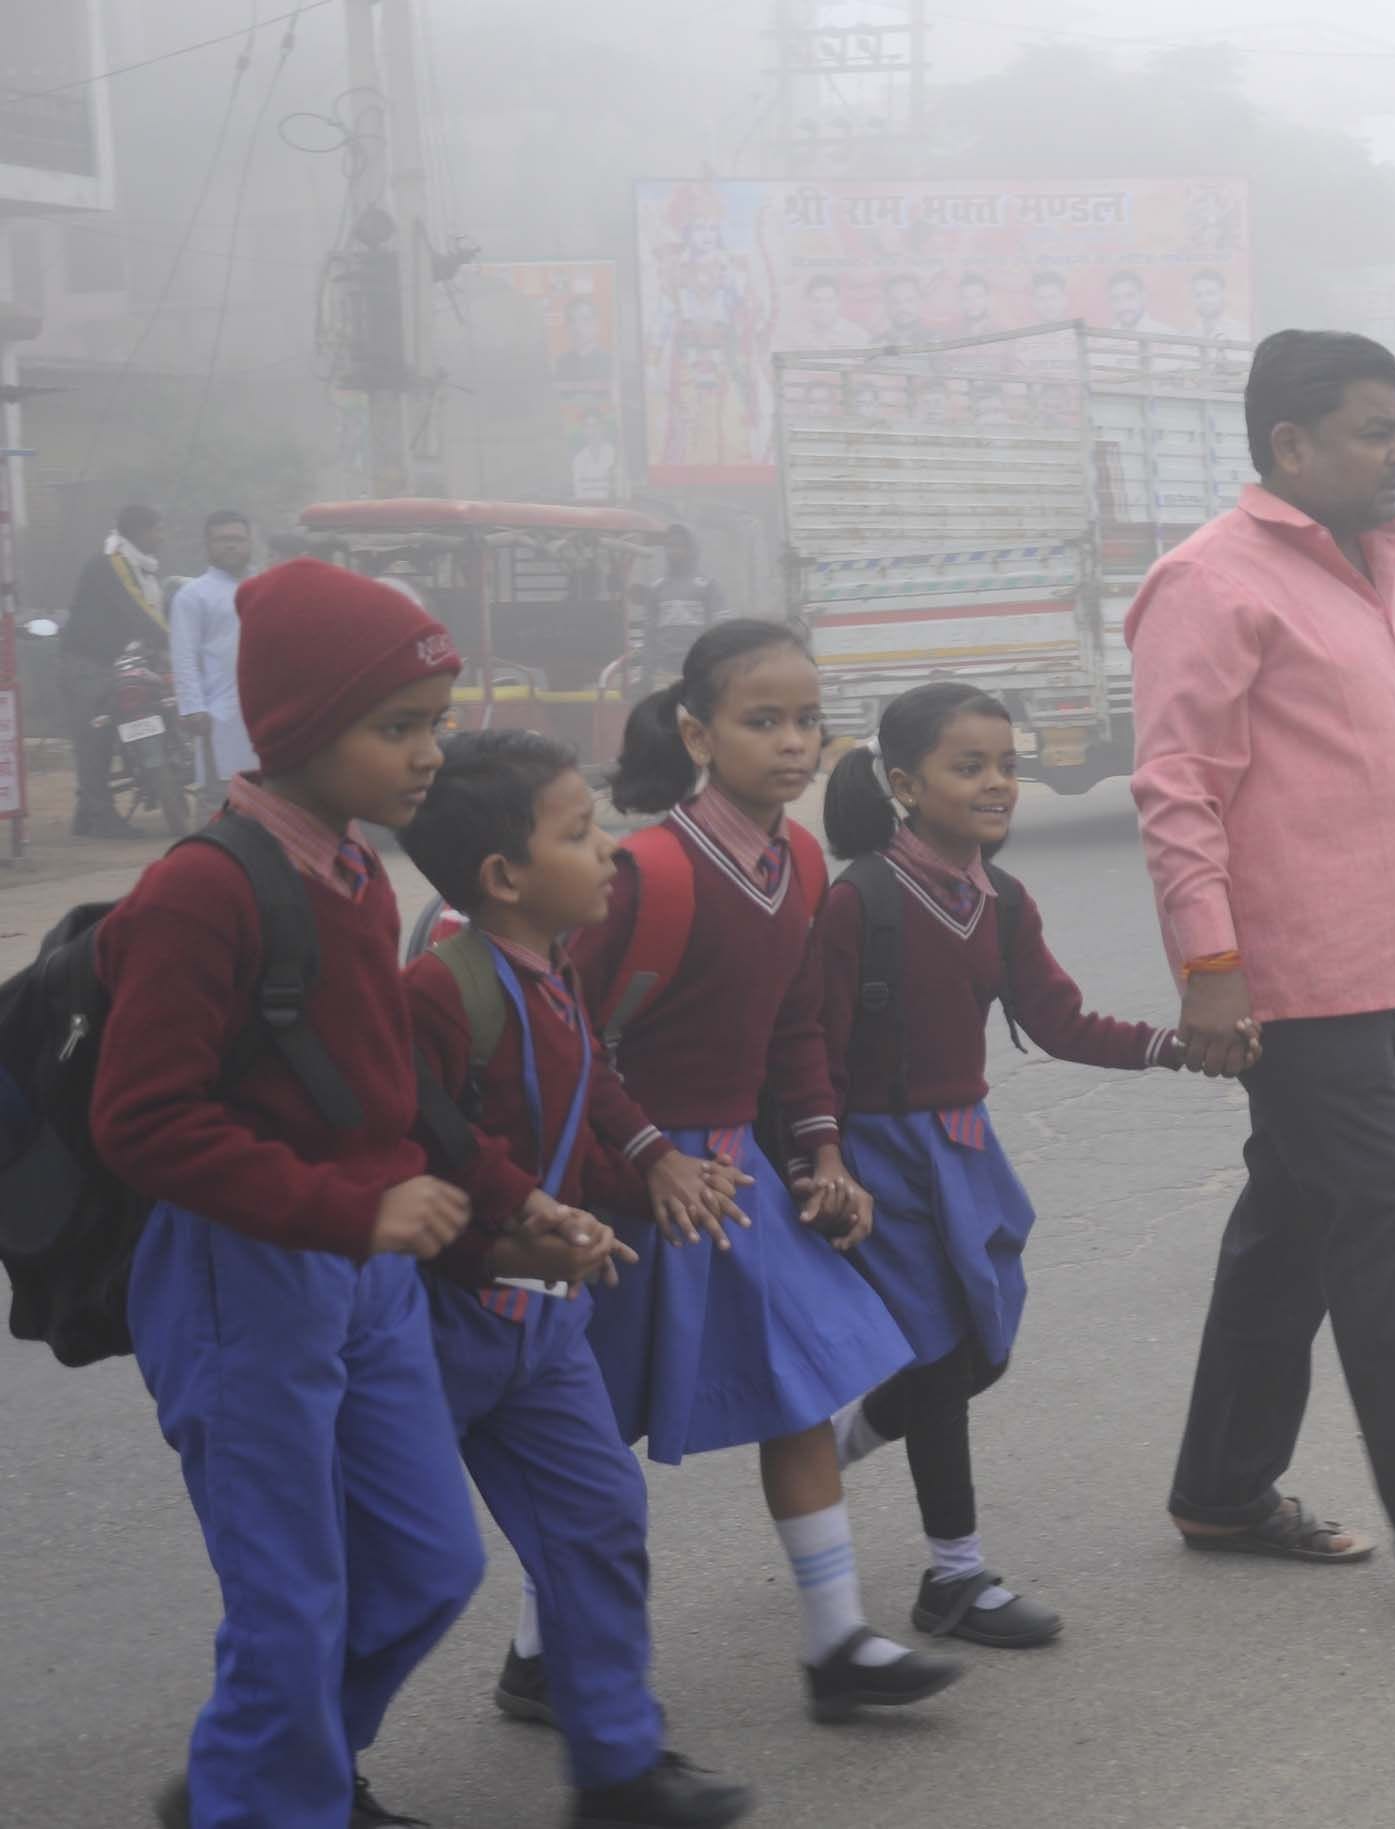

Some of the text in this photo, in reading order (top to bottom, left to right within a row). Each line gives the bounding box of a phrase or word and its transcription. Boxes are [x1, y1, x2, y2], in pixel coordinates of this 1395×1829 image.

[784, 185, 827, 226] श्री
[842, 195, 905, 227] राम
[920, 193, 1000, 227] भक्त
